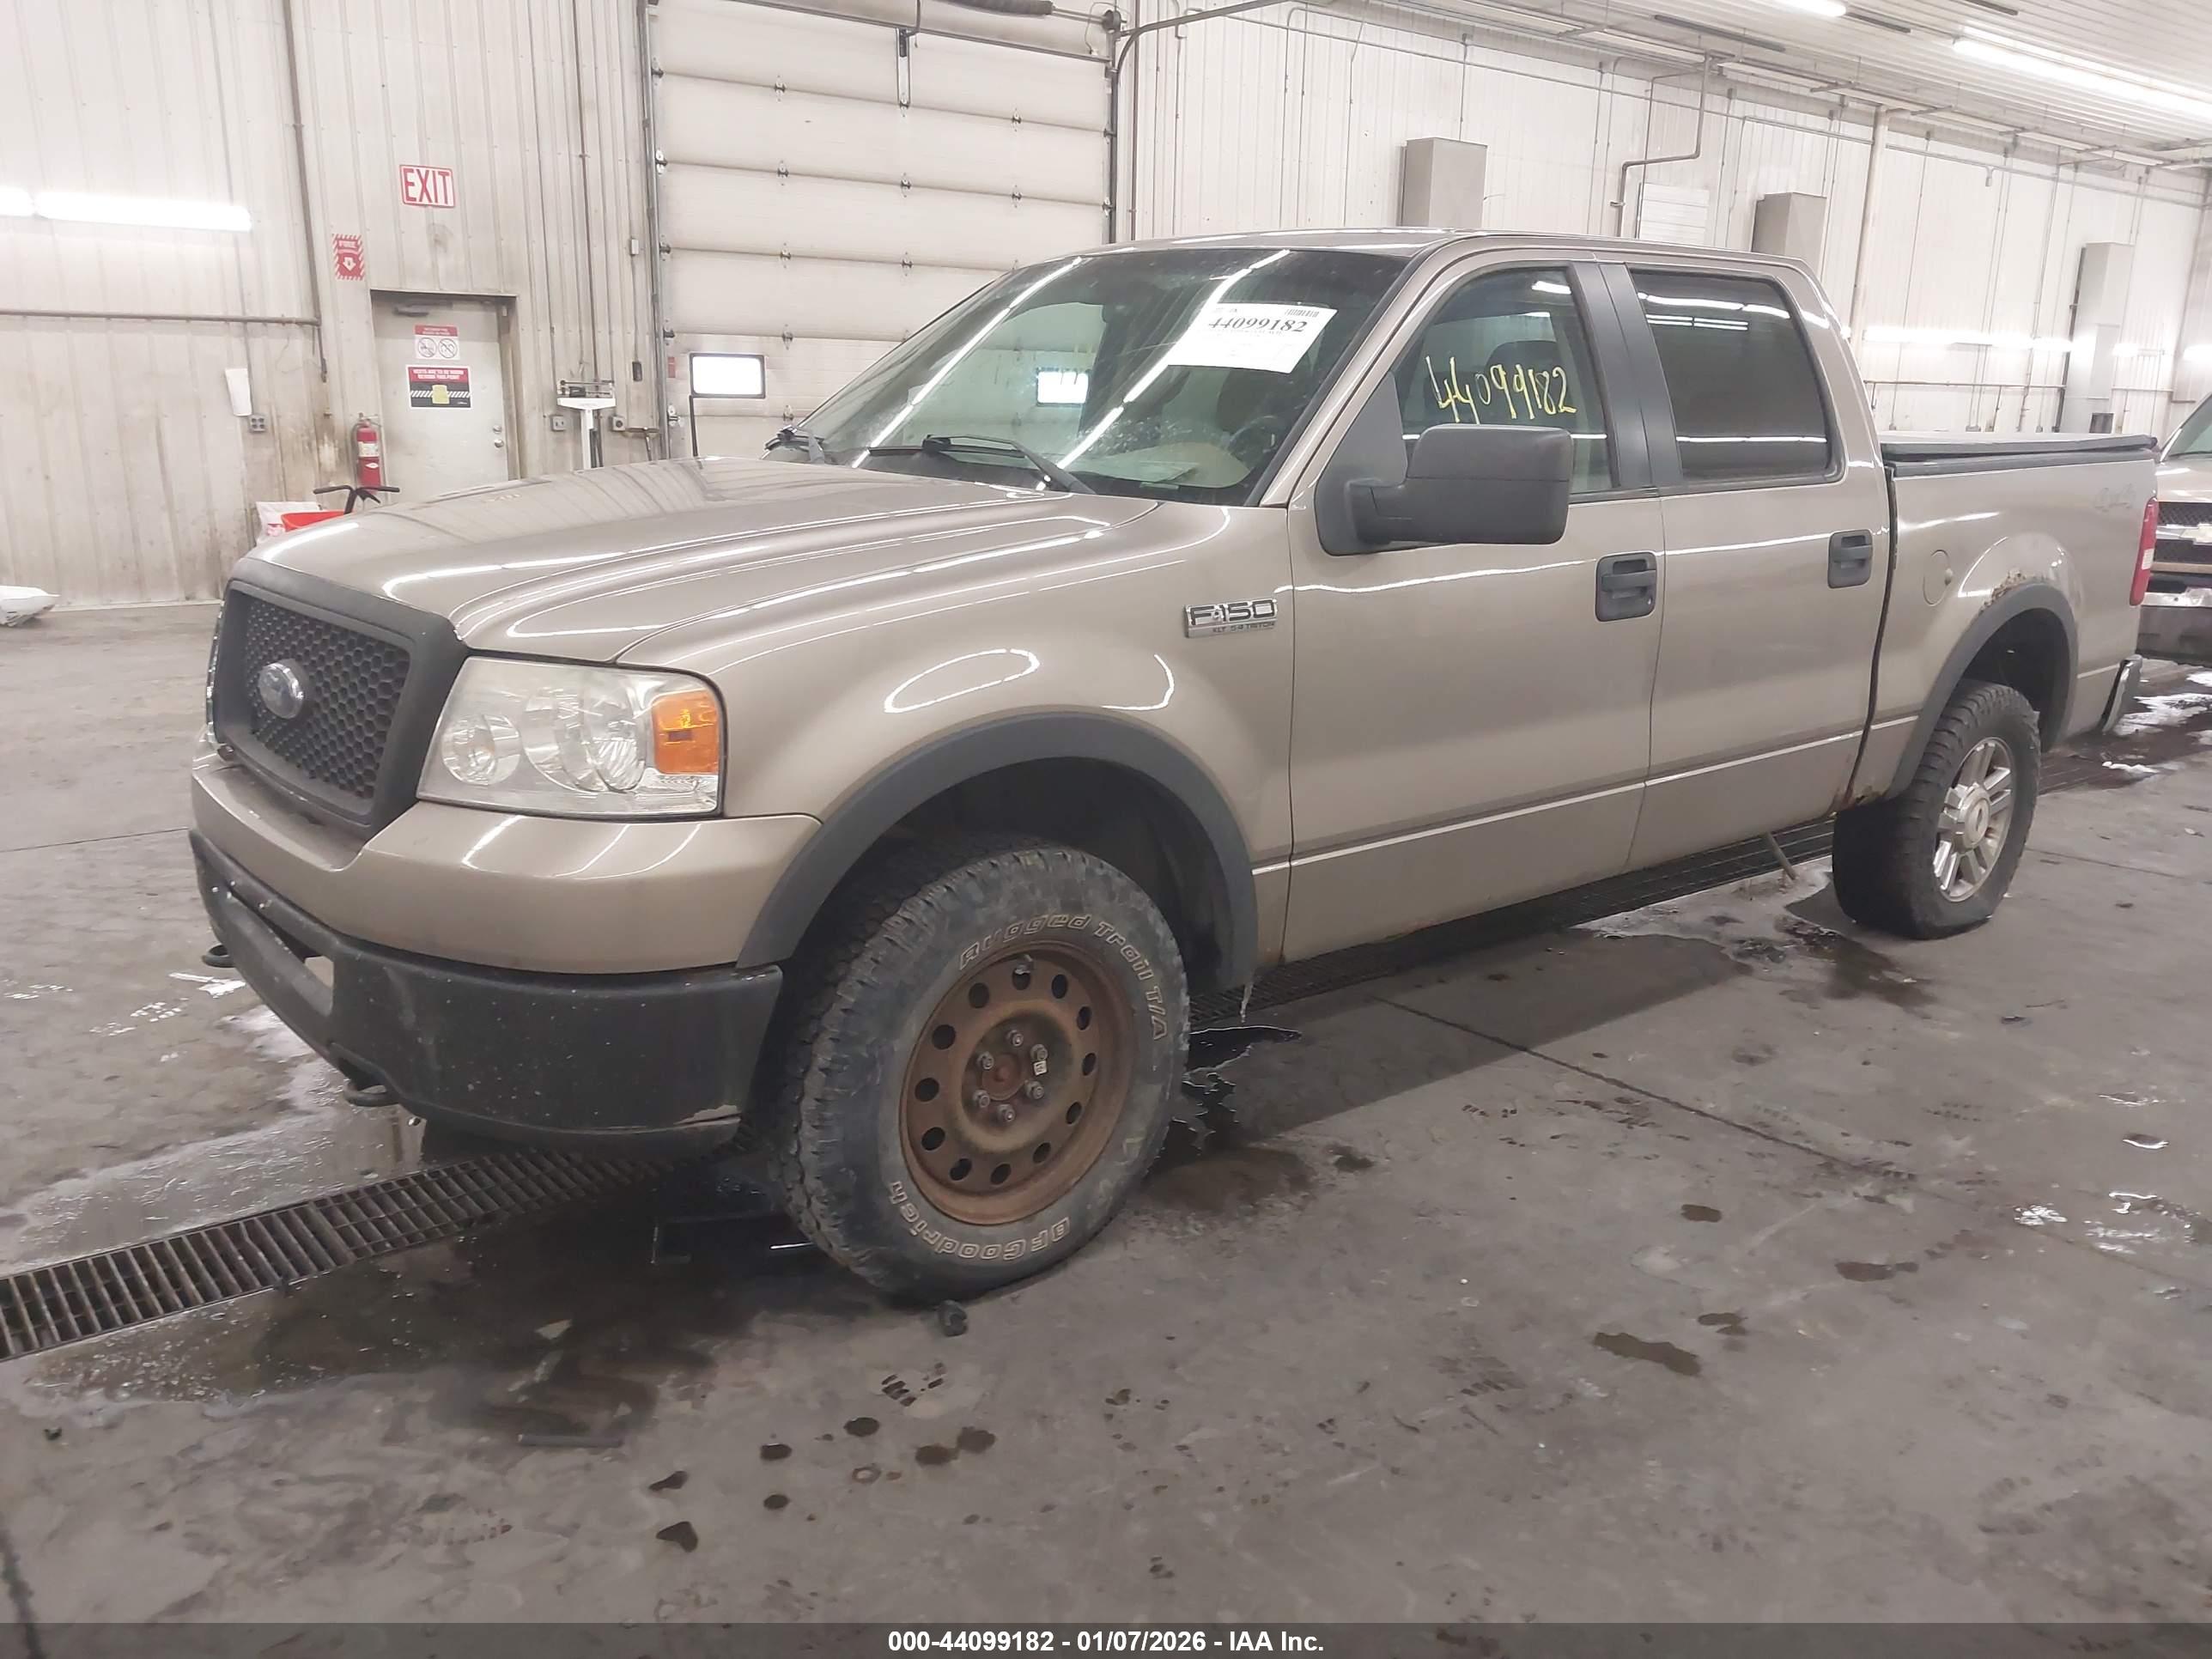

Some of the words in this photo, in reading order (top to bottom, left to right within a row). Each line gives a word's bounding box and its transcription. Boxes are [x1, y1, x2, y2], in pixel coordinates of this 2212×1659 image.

[403, 168, 451, 204] EXIT
[1209, 316, 1308, 333] 44099182
[1425, 356, 1577, 424] 44099182
[959, 914, 1091, 970] Rugged
[1094, 921, 1154, 981] Trail
[1145, 985, 1168, 1040] T/A
[889, 1181, 1070, 1261] BFGoodrich
